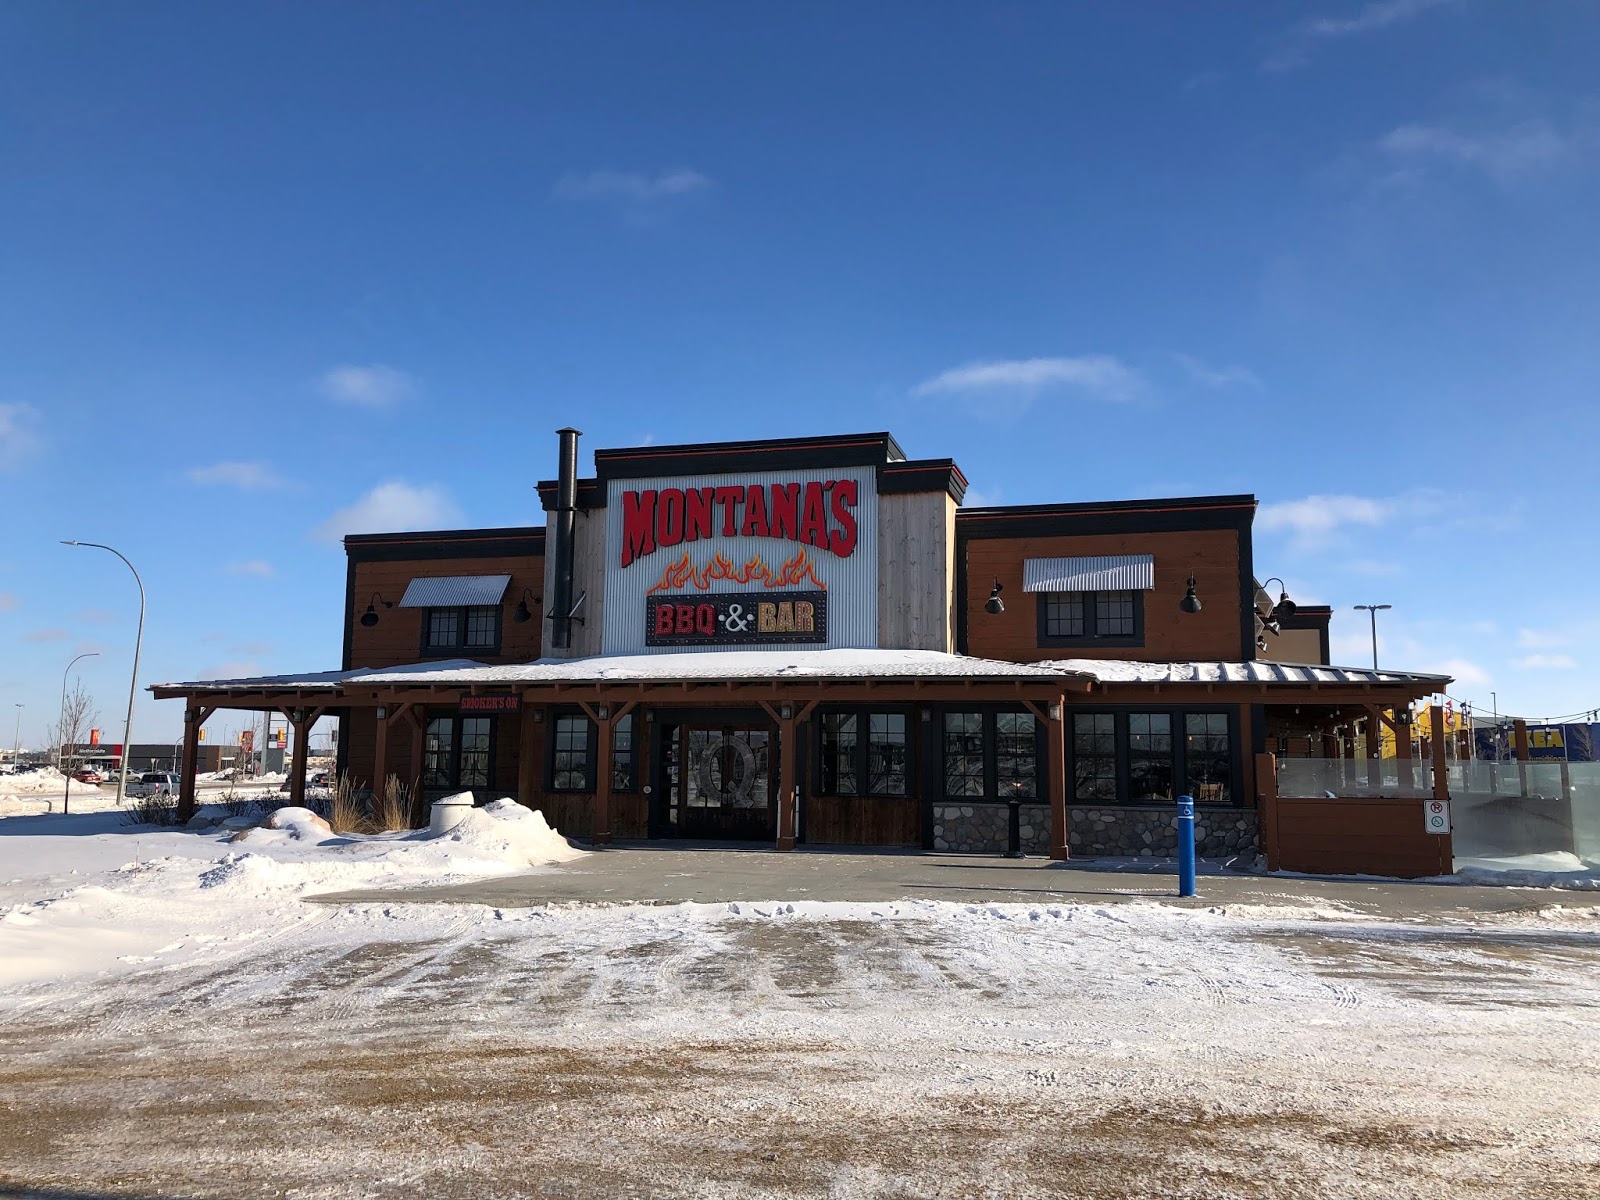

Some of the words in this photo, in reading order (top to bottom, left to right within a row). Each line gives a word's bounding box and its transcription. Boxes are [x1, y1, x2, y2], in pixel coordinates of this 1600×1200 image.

[621, 479, 858, 568] MONTANA'S
[655, 603, 716, 637] BBQ
[757, 601, 815, 633] BAR
[461, 696, 505, 709] SMOKER'S
[505, 696, 518, 709] ON
